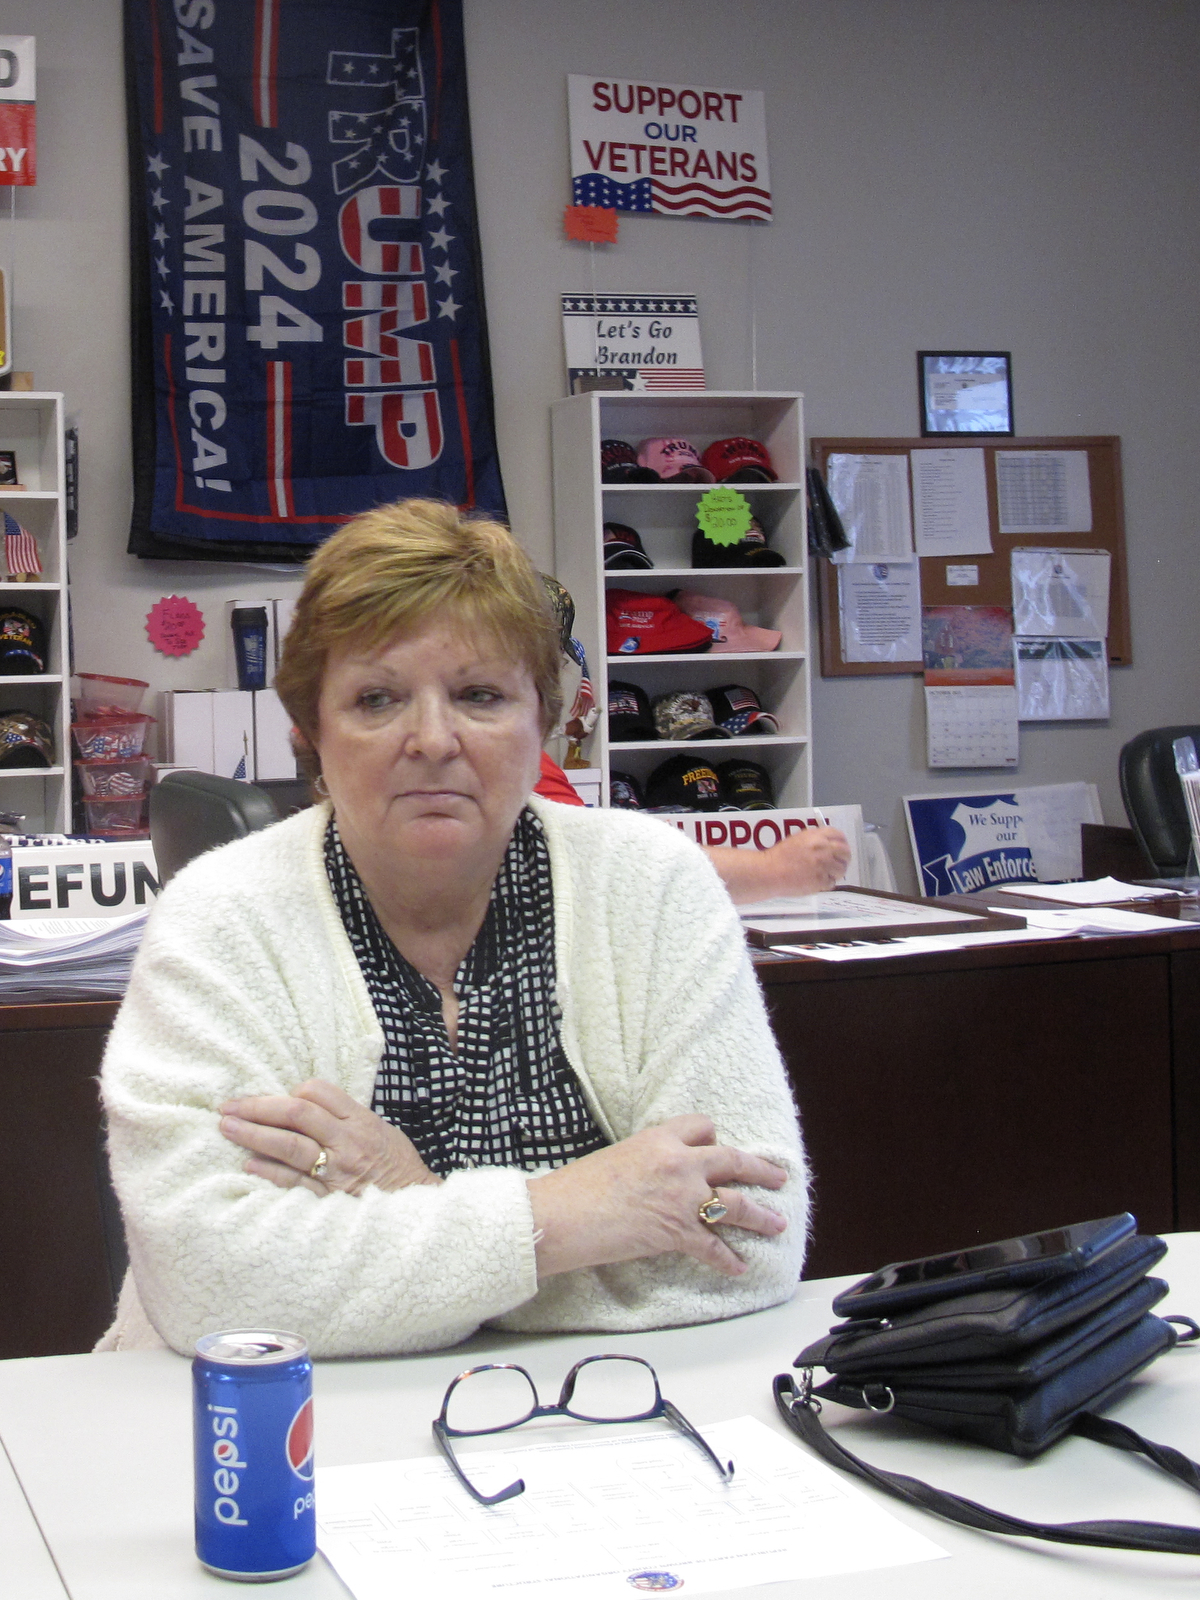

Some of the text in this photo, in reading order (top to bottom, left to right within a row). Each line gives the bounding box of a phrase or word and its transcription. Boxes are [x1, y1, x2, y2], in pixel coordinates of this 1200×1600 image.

[592, 81, 743, 123] SUPPORT
[644, 121, 698, 143] OUR
[582, 140, 758, 182] VETERANS
[173, 0, 232, 492] SAVE AMERICA!
[238, 133, 324, 349] 2024
[326, 27, 445, 470] TRUMP
[597, 320, 673, 339] Let's Go
[595, 346, 678, 365] Brandon
[969, 812, 1024, 828] We Supp
[996, 831, 1017, 842] our
[18, 861, 163, 911] EFUN
[951, 852, 1037, 892] Law Enforce
[207, 1403, 249, 1526] pepsi
[293, 1490, 315, 1520] pe
